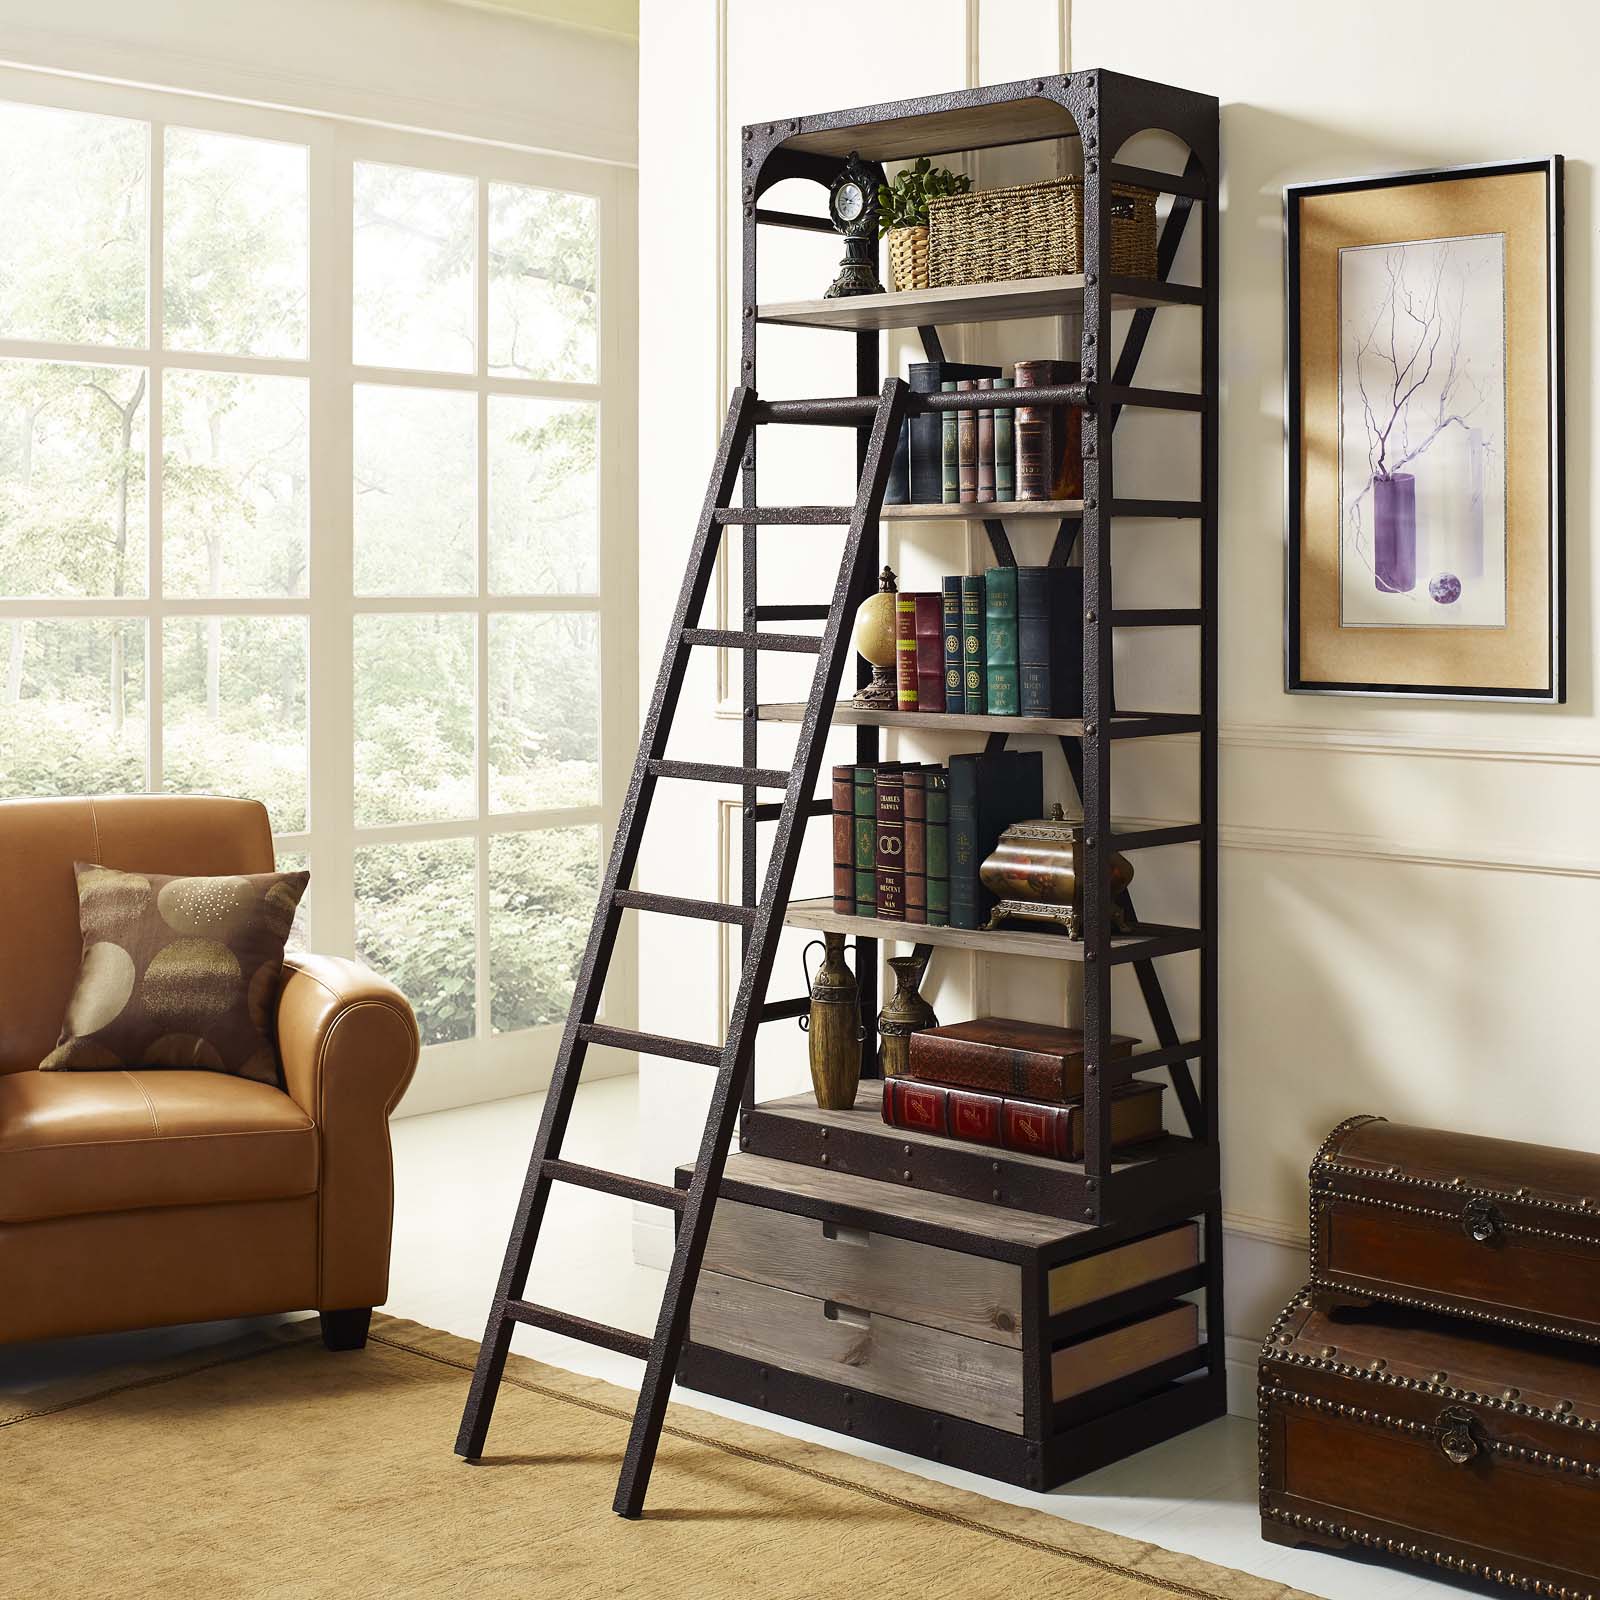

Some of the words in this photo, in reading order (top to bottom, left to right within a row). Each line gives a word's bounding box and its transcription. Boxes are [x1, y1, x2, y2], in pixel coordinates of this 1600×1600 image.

[880, 795, 900, 803] CHARLES
[880, 884, 901, 893] DESCENT
[884, 900, 895, 908] MAN
